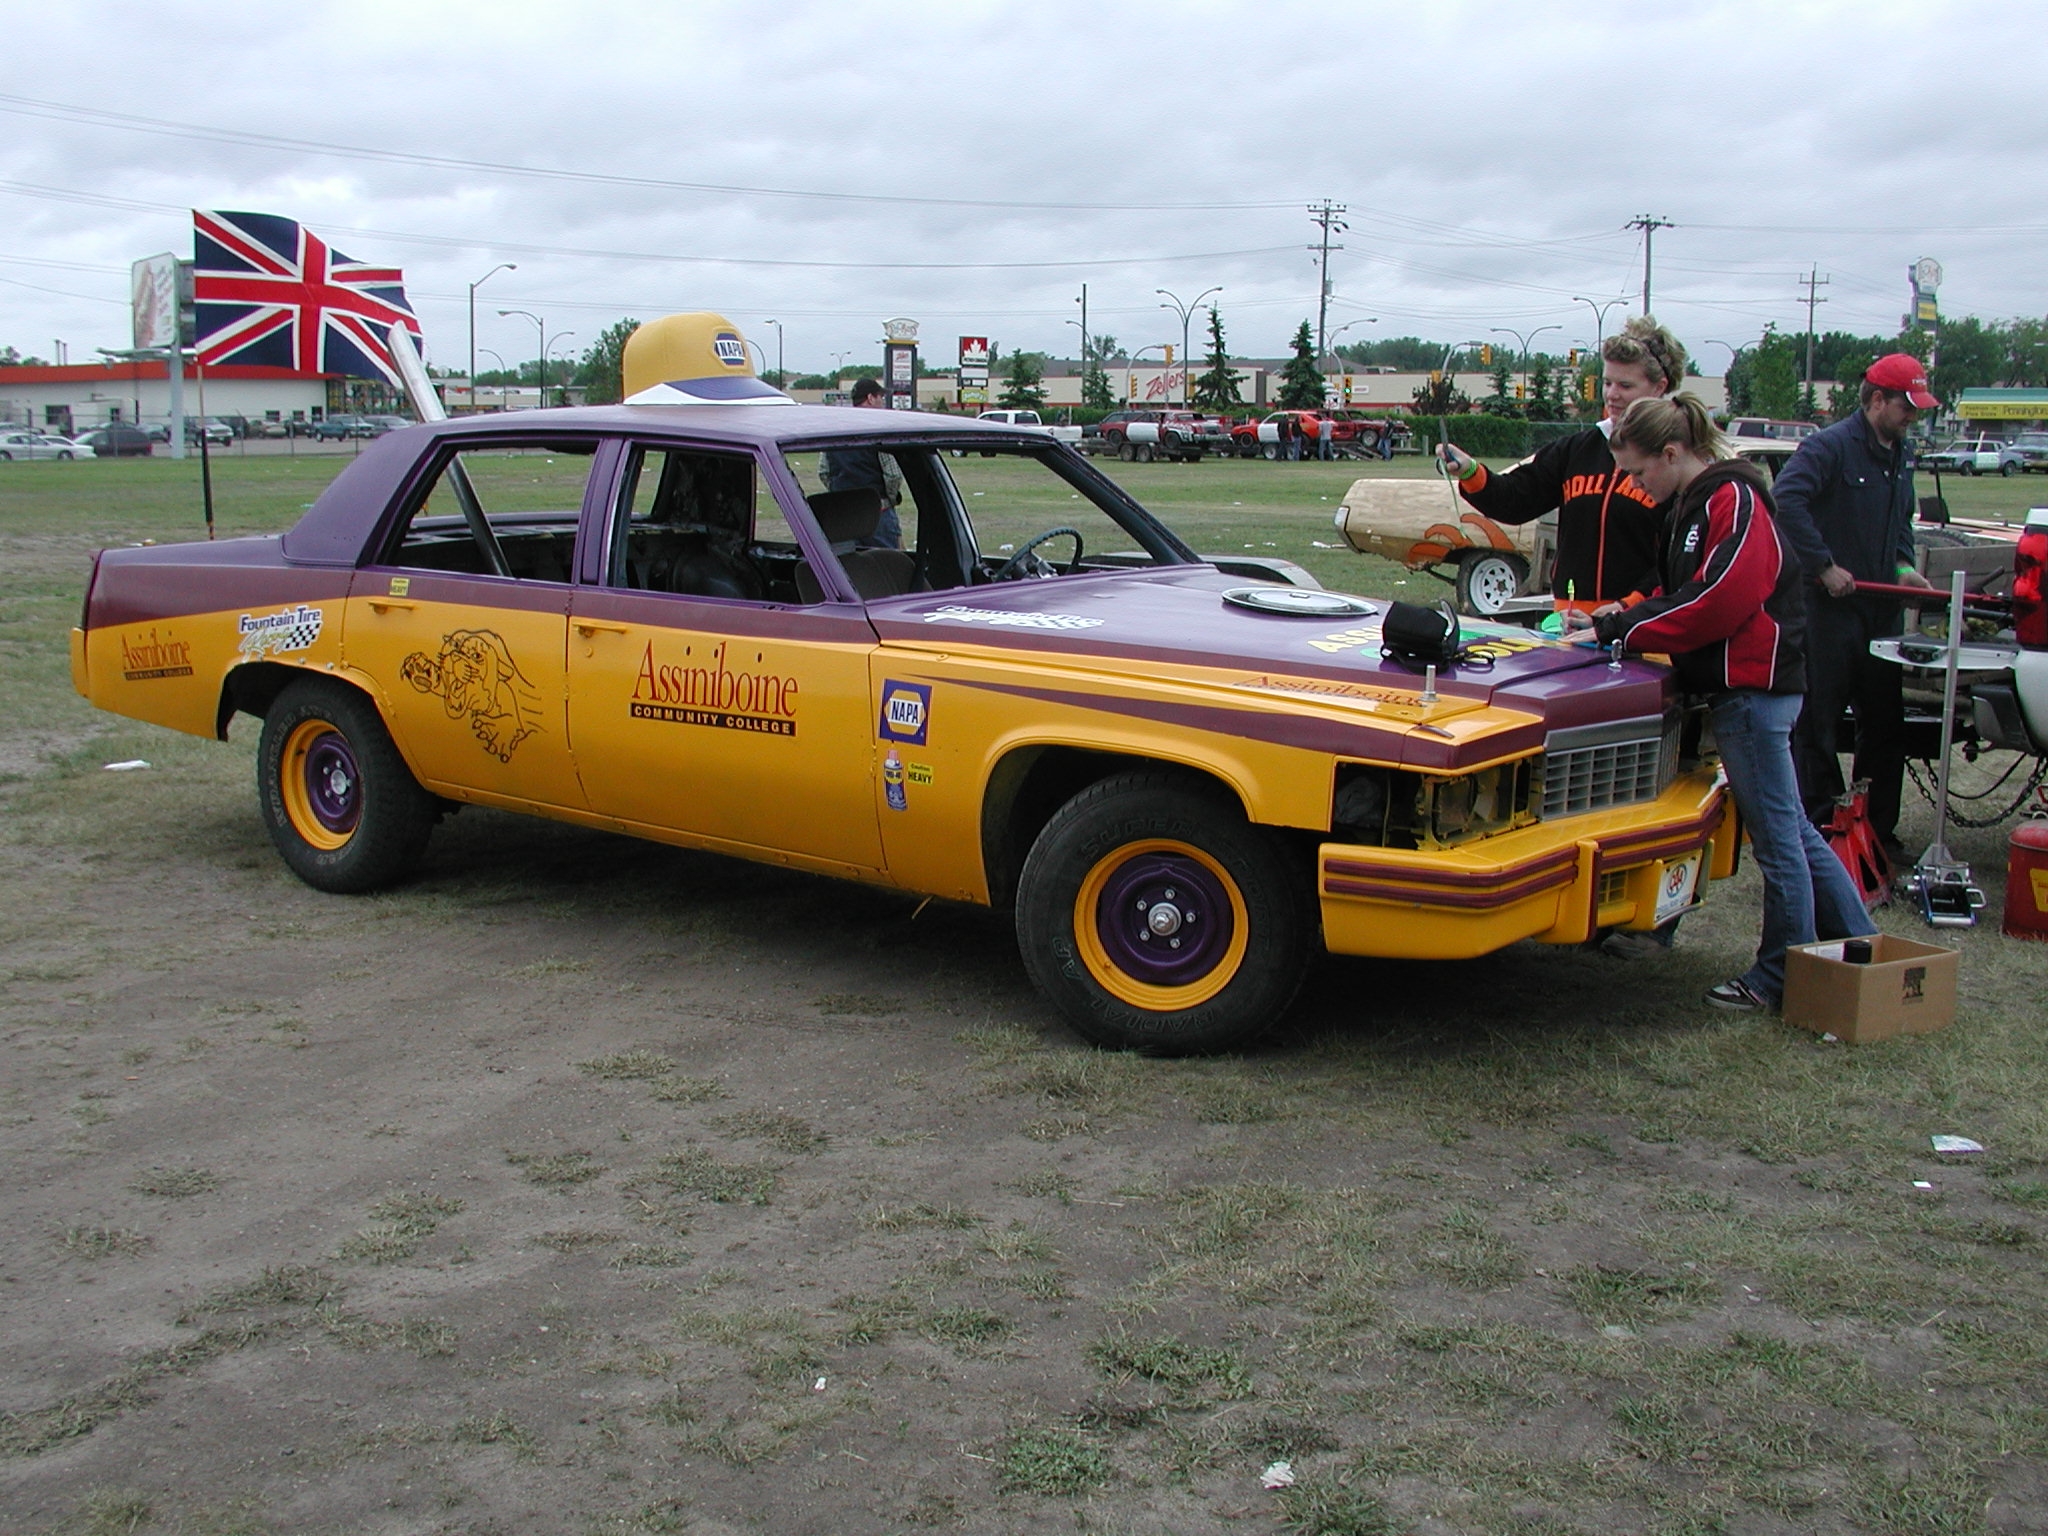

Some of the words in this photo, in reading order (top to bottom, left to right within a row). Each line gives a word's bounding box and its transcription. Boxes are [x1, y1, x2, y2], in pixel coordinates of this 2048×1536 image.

[718, 341, 742, 357] NAPA
[1145, 370, 1184, 400] Zellers
[241, 612, 295, 632] Fountain
[298, 607, 320, 624] Tire
[122, 627, 191, 670] Assiniboine
[632, 638, 798, 717] Assiniboine
[634, 705, 719, 725] COMMUNITY
[725, 715, 791, 734] COLLEGE
[891, 700, 919, 724] NAPA
[908, 771, 932, 784] HEAVY
